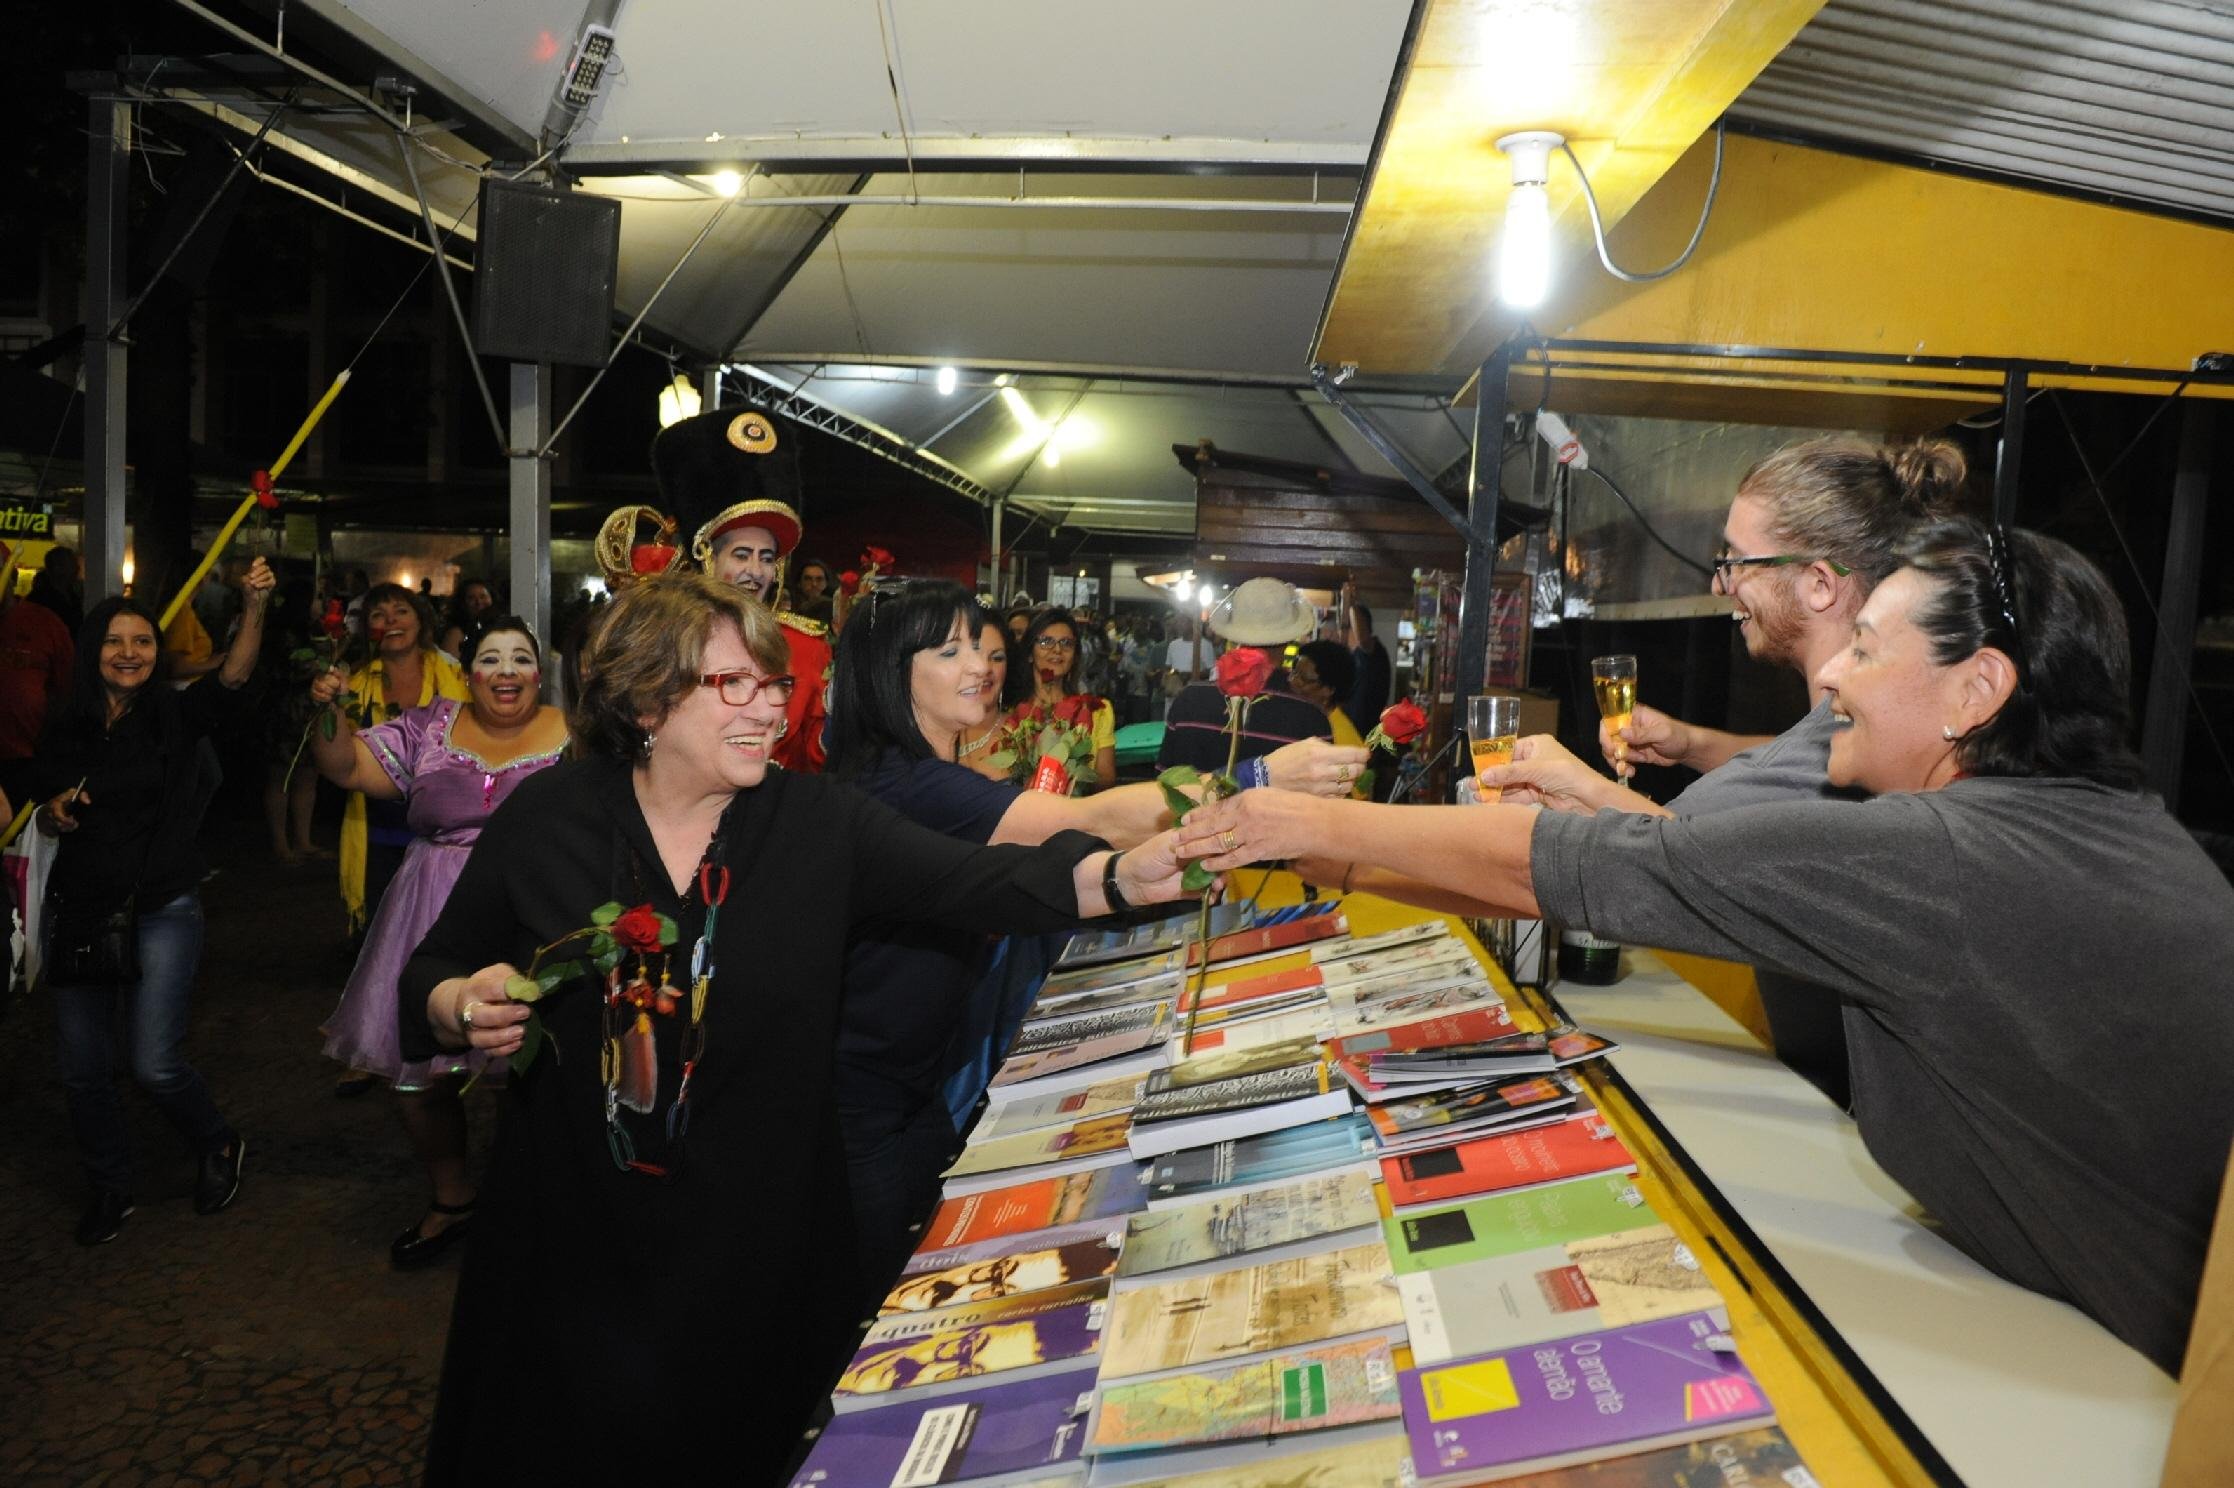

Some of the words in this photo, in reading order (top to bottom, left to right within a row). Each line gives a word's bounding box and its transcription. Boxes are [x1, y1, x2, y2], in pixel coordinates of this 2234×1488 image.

[1534, 1348, 1576, 1401] alemão
[1571, 1340, 1602, 1356] O
[1577, 1355, 1625, 1415] amante
